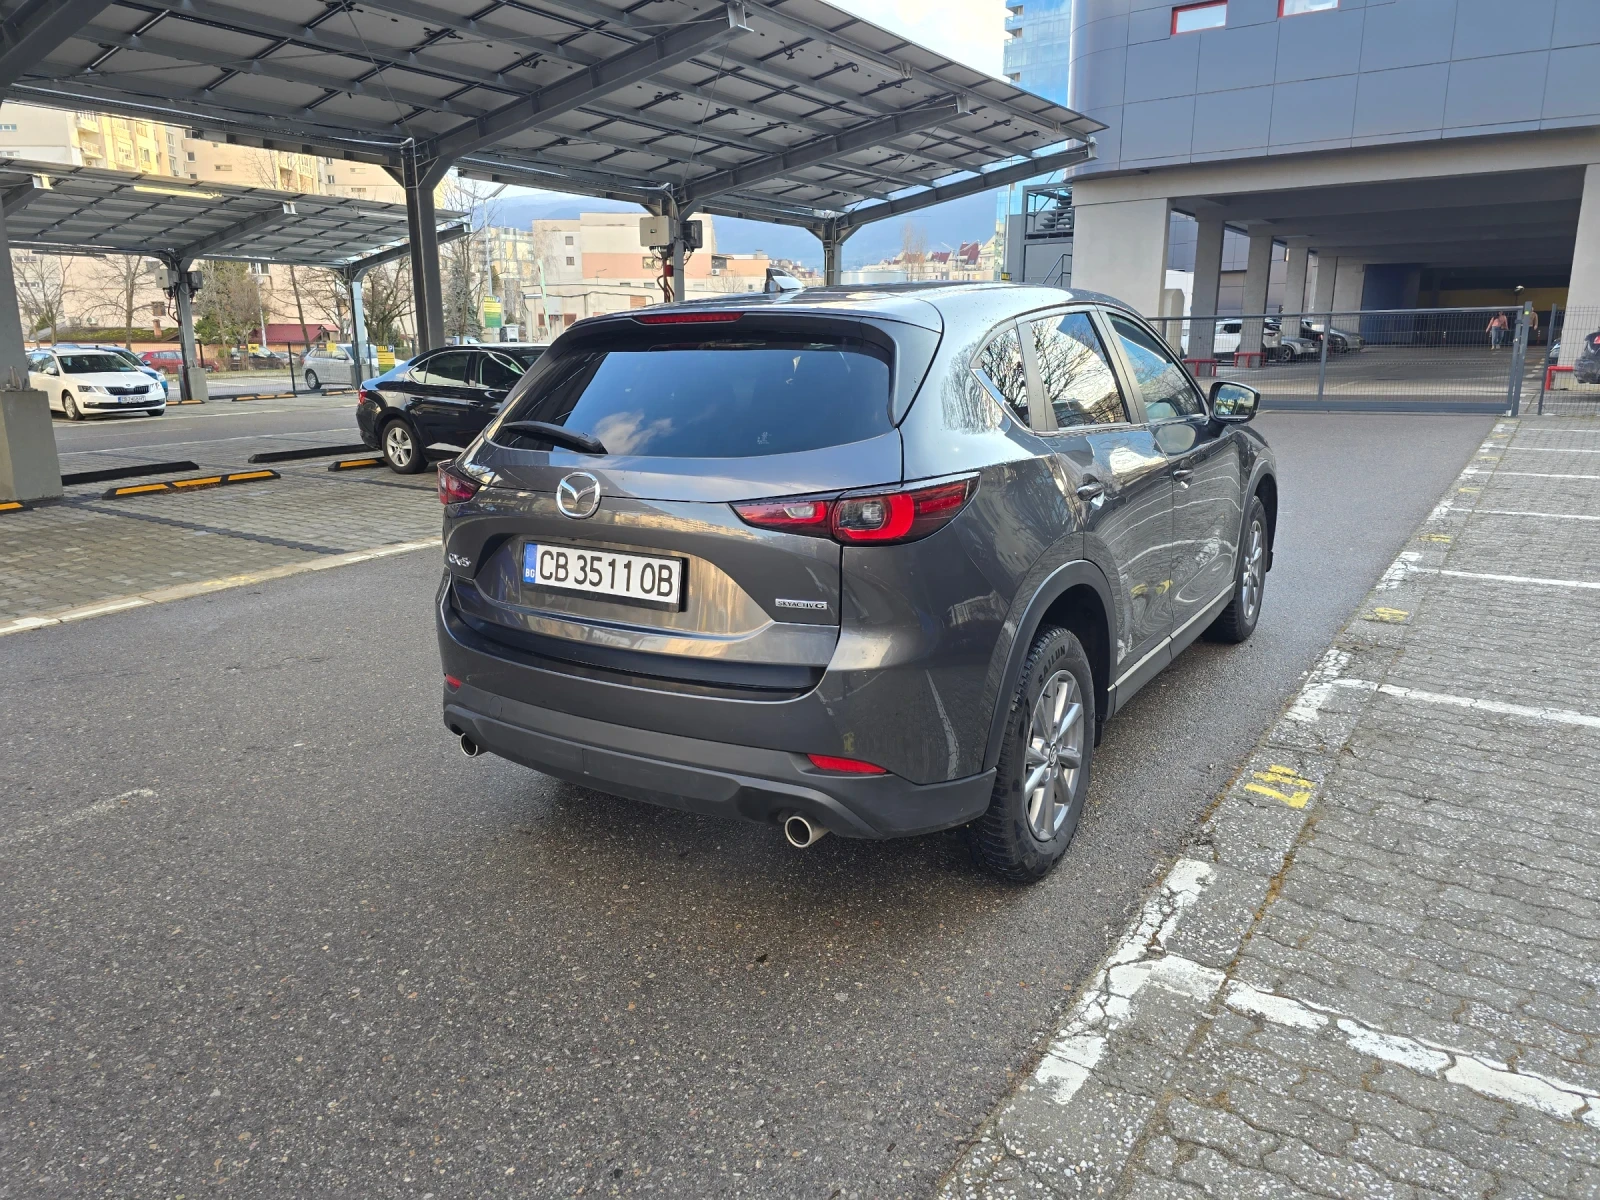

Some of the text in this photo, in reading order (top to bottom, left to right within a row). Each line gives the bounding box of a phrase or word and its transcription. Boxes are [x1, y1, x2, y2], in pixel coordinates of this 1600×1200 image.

[525, 568, 535, 578] BG
[539, 549, 569, 582] CB
[574, 554, 632, 592] 3511
[1038, 644, 1066, 687] SAILUN
